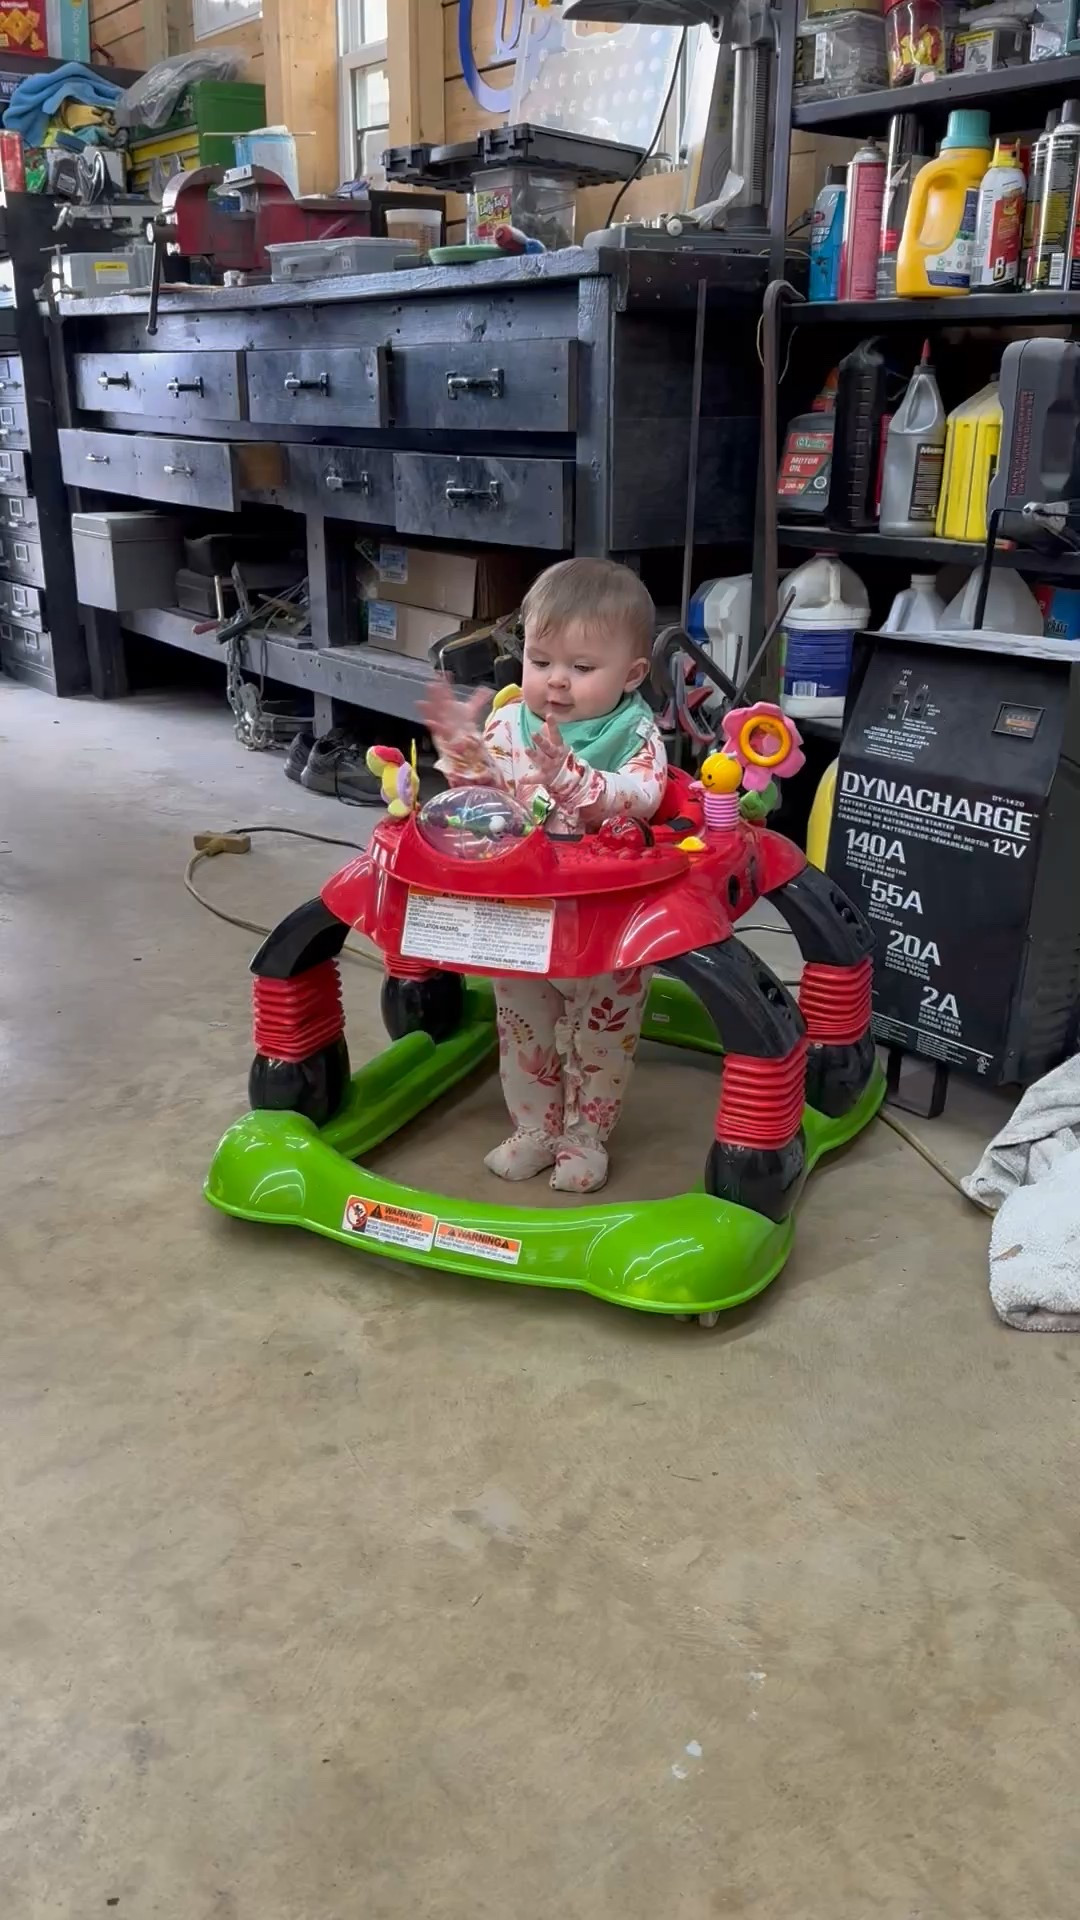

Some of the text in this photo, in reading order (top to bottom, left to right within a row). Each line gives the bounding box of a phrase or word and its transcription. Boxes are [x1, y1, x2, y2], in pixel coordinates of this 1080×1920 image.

[788, 464, 801, 473] OIL
[790, 457, 819, 465] MOTOR
[841, 771, 1033, 836] DYNACHARGE
[992, 795, 1025, 808] DY-1420
[837, 812, 871, 825] CHARGEUR
[871, 820, 880, 828] DE
[839, 797, 867, 810] BATTERY
[925, 817, 955, 831] STARTER
[838, 805, 872, 819] CARGADOR
[873, 813, 882, 821] DE
[953, 833, 962, 841] DE
[964, 836, 989, 849] MOTOR
[846, 828, 906, 864] 140A
[992, 838, 1027, 859] 12V
[886, 866, 907, 876] MOTOR
[870, 879, 923, 914] 55A
[887, 929, 941, 966] 20A
[885, 962, 908, 973] CHARGE
[905, 955, 929, 968] CHARGE
[920, 985, 960, 1018] 2A
[917, 1017, 942, 1031] CHARGE
[937, 1011, 962, 1025] CHARGE
[384, 1206, 423, 1222] WARNING
[457, 1229, 502, 1247] WARNING
